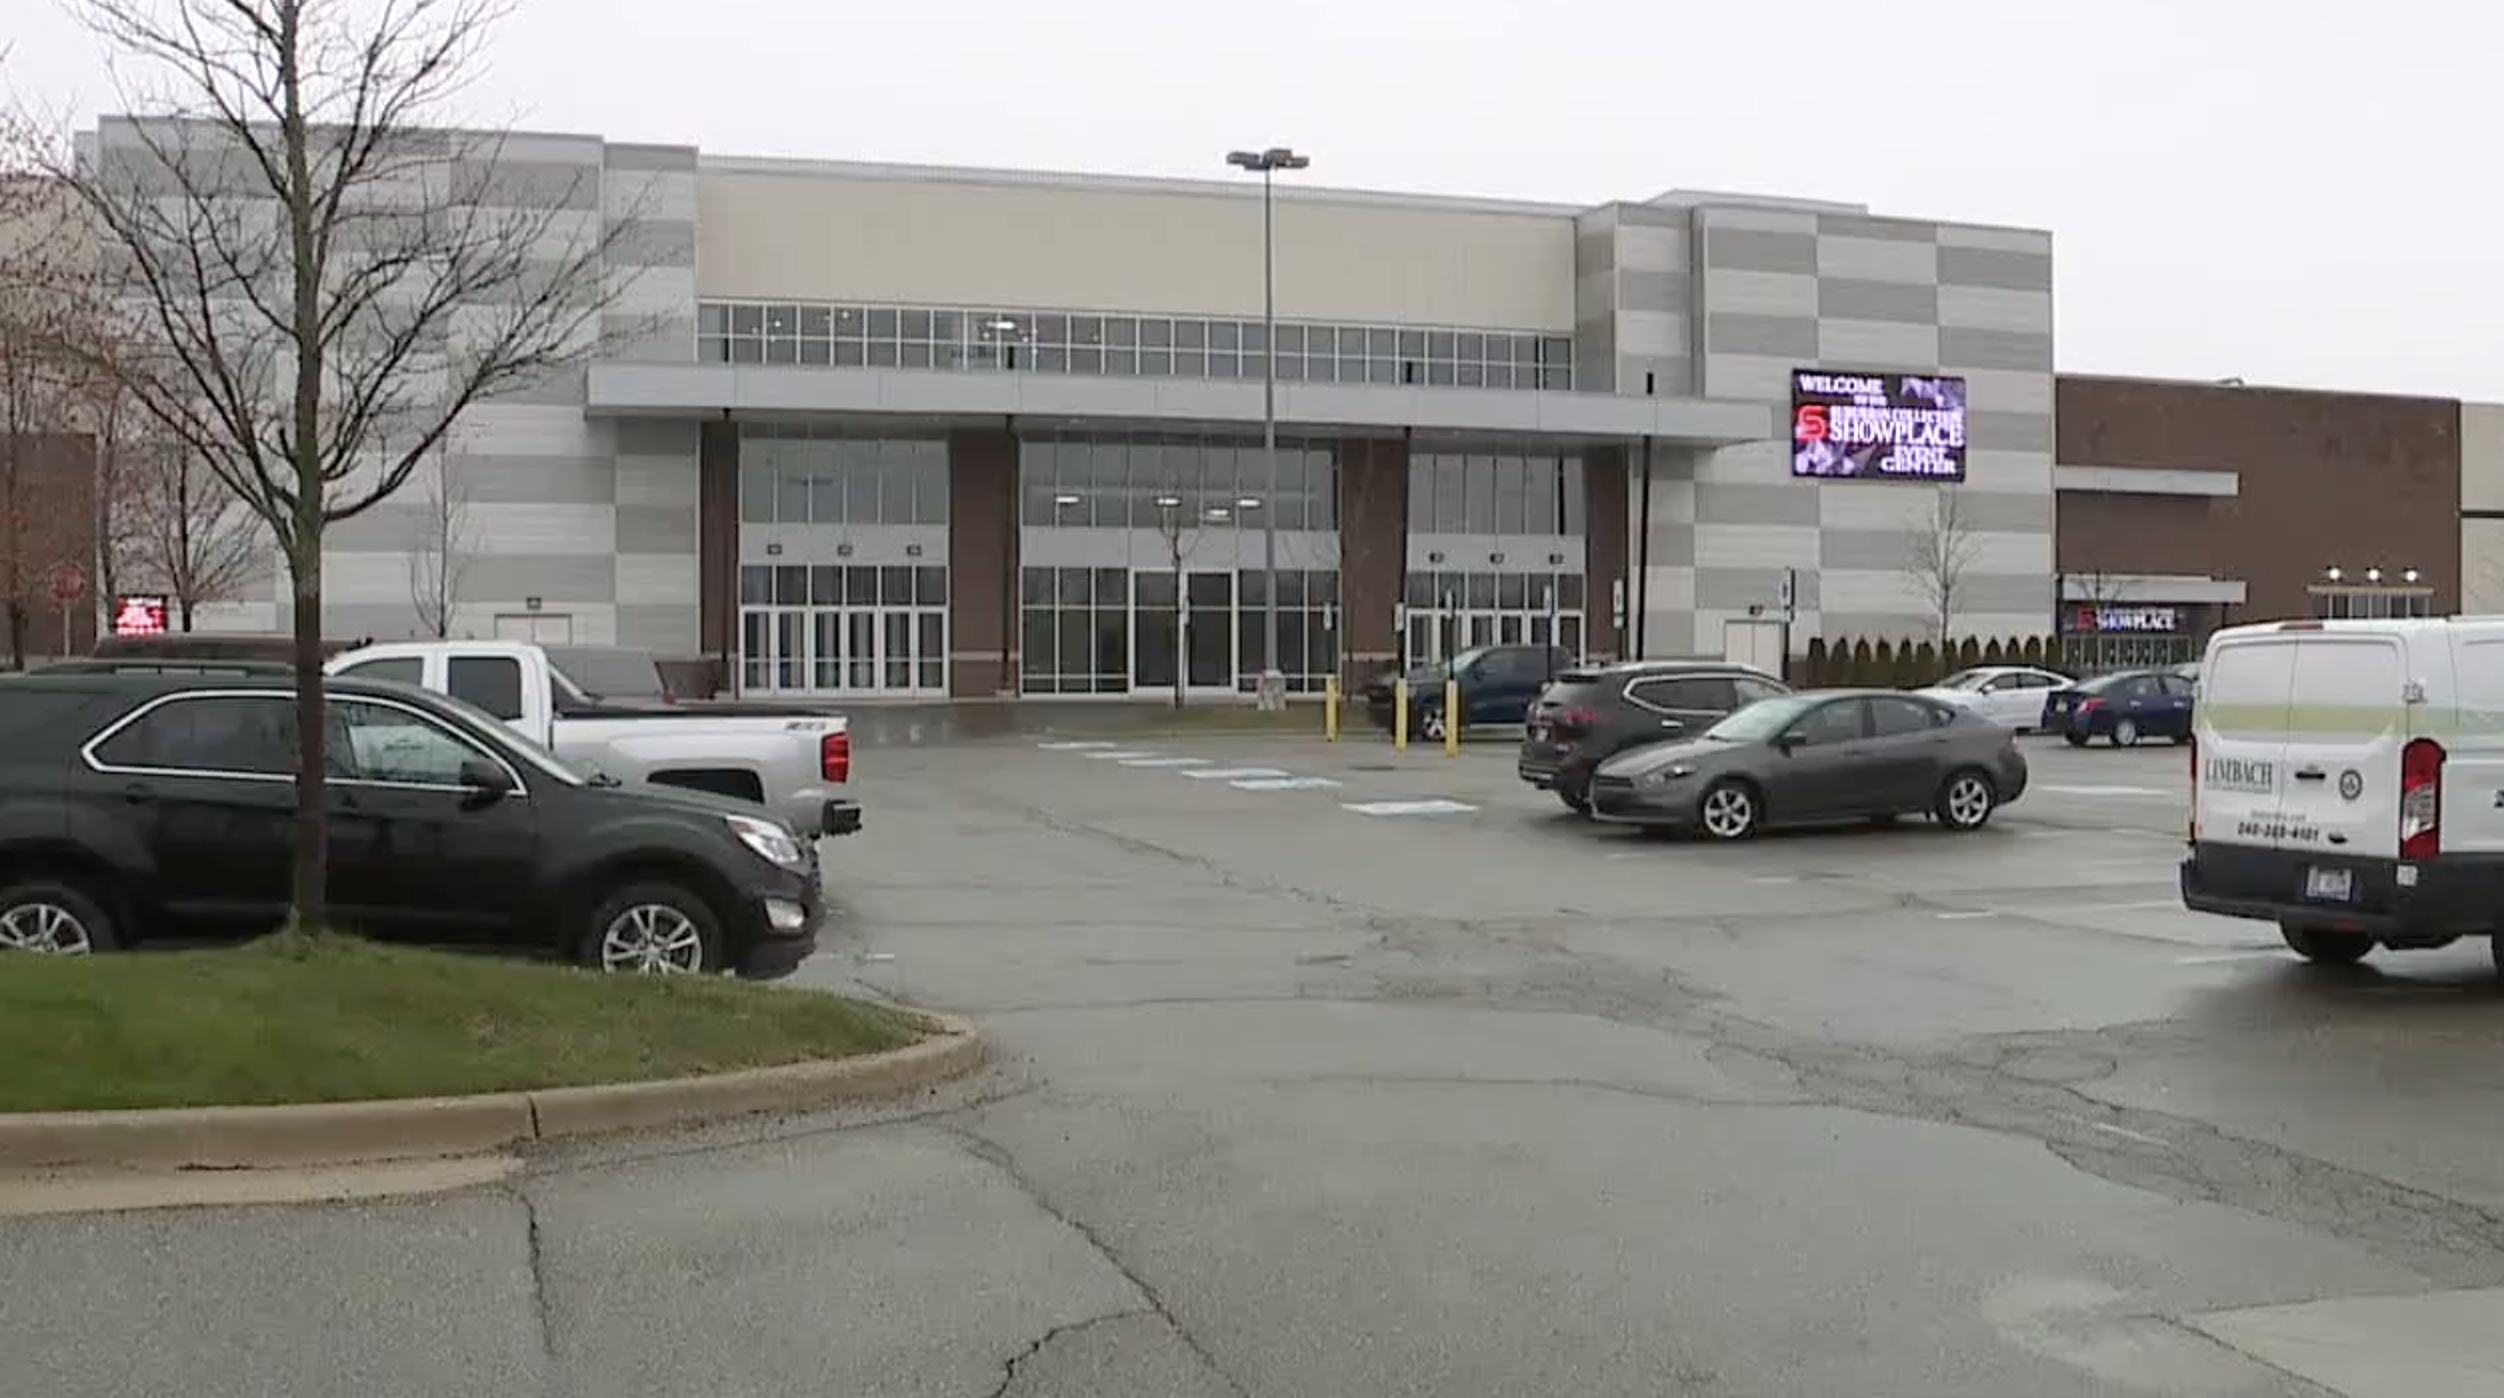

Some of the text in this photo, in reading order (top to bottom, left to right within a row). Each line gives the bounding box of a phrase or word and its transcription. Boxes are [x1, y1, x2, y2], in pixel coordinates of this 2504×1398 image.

[1799, 374, 1883, 395] WELCOME
[1829, 419, 1964, 447] SHOWPLACE
[1880, 456, 1957, 475] CENTER
[2204, 758, 2273, 787] LIMBACH
